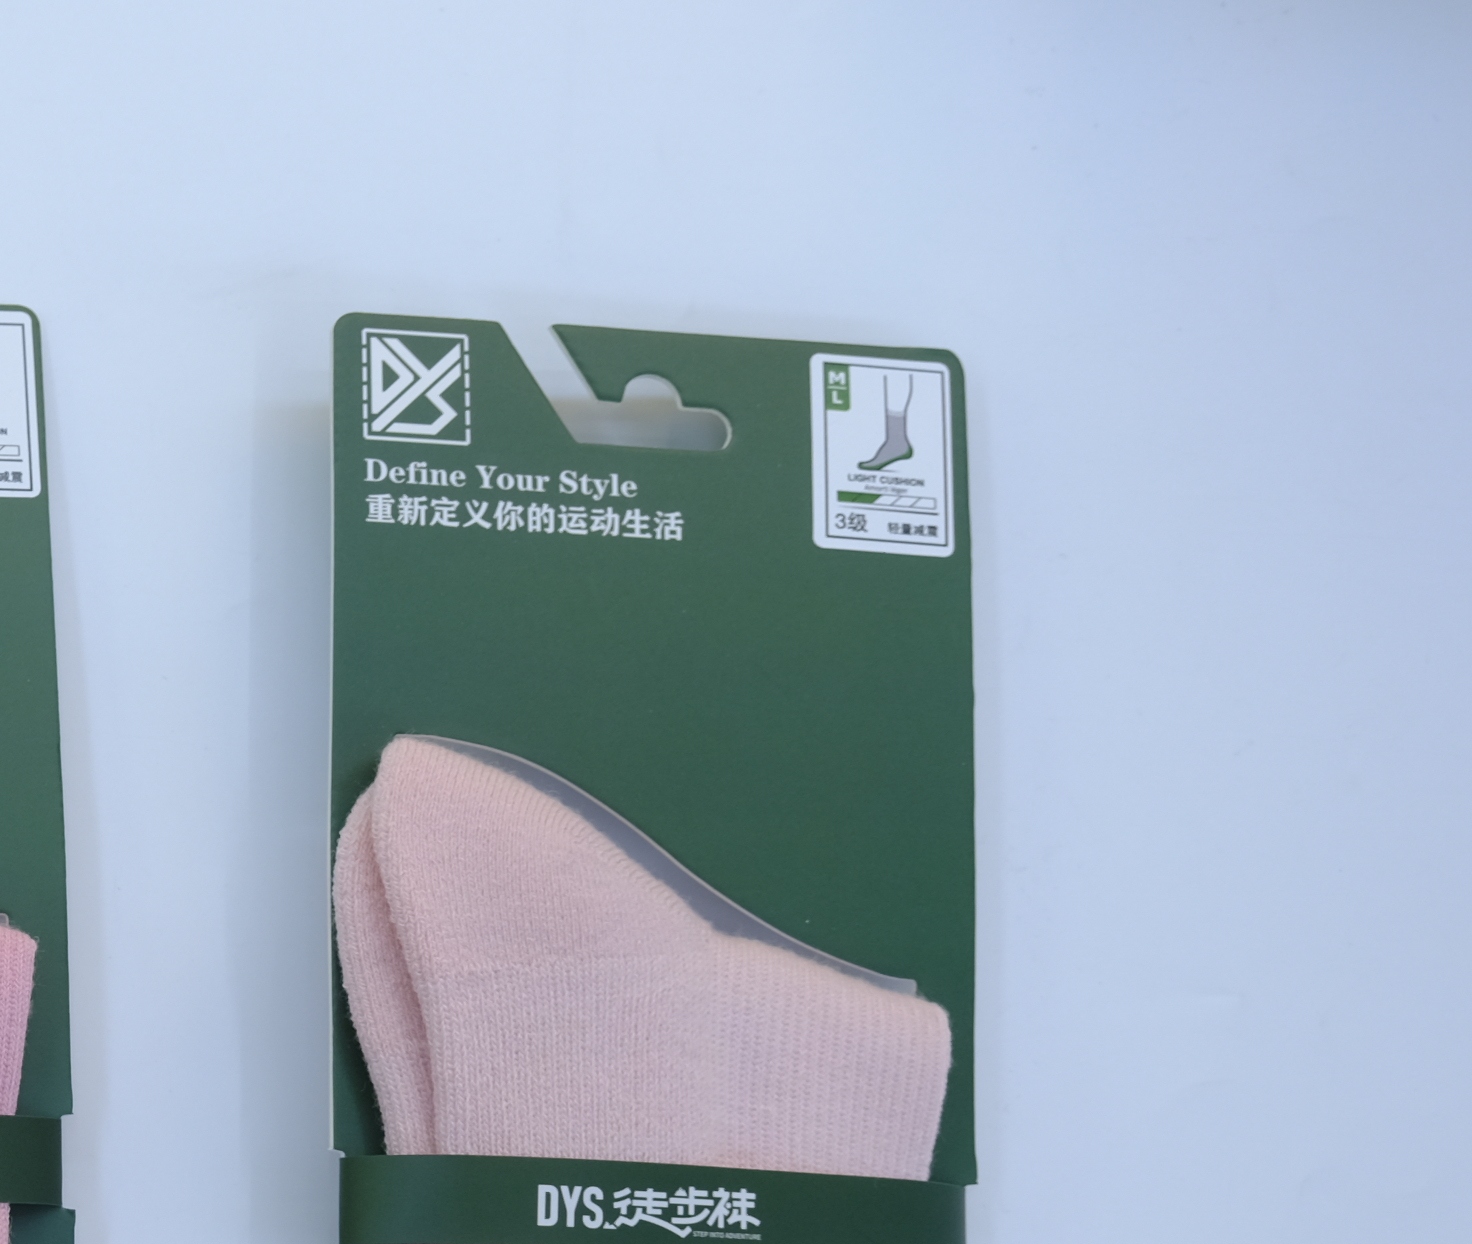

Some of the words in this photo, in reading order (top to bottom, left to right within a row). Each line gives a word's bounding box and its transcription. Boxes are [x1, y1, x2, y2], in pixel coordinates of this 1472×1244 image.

[828, 371, 846, 385] M
[832, 391, 842, 404] L
[364, 459, 466, 488] Define
[478, 465, 551, 491] Your
[559, 470, 638, 499] Style
[365, 495, 684, 542] 重新定义你的运动生活
[835, 513, 867, 532] 3级
[613, 1187, 761, 1238] 徒步袜
